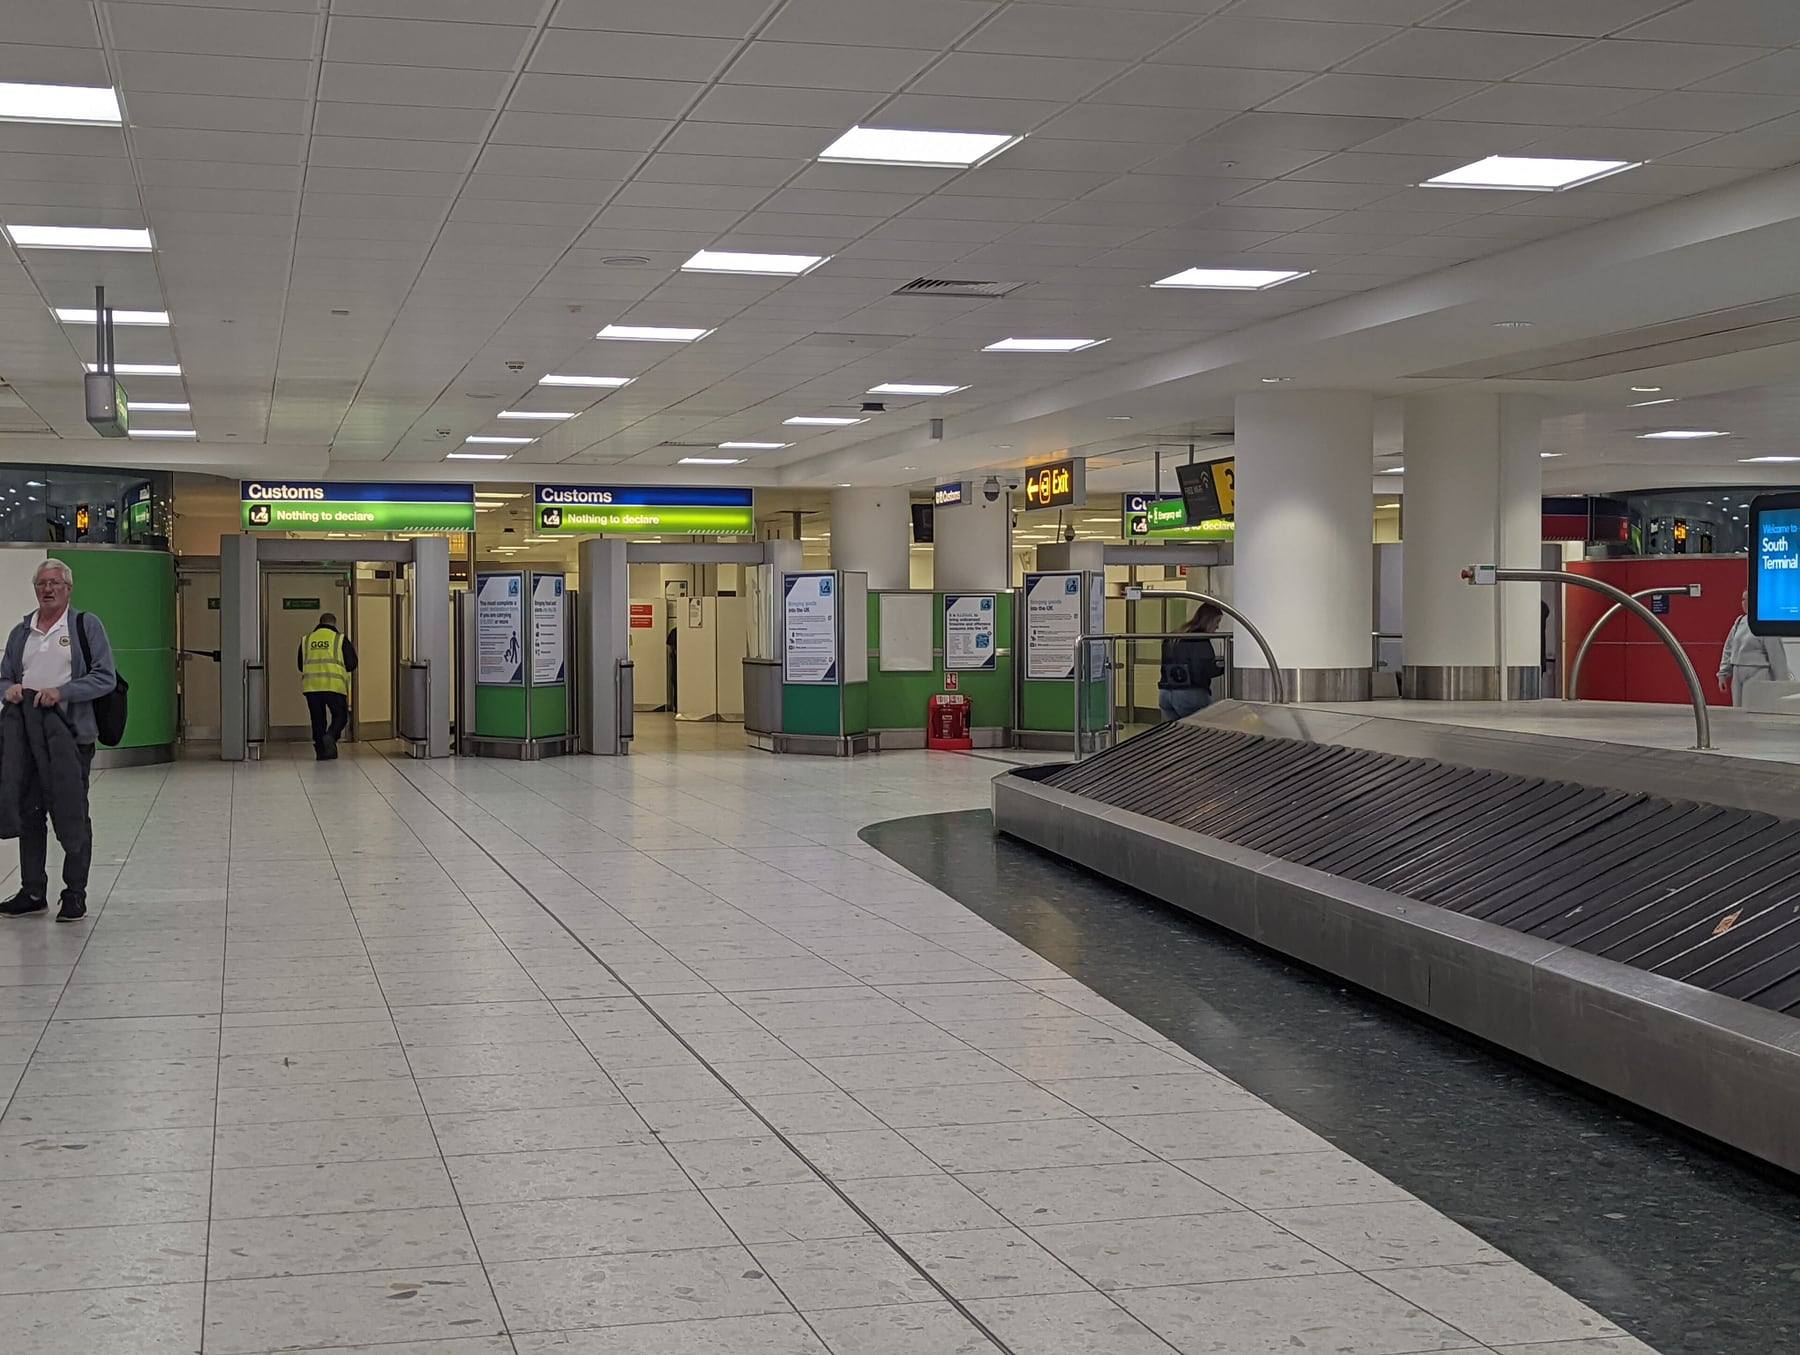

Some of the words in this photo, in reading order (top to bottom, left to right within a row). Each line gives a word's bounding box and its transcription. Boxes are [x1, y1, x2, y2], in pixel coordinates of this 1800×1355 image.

[1052, 468, 1069, 494] Exit
[248, 484, 324, 500] Customs
[541, 487, 612, 503] Customs
[943, 490, 961, 502] Customs
[277, 510, 319, 523] Nothing
[321, 511, 333, 521] to
[335, 511, 374, 522] declare
[567, 513, 608, 526] Nothing
[610, 514, 620, 525] to
[622, 514, 660, 525] declare
[1202, 517, 1235, 531] declare
[1763, 524, 1789, 534] Welcome
[1791, 524, 1797, 533] to
[1762, 536, 1788, 552] South
[1762, 553, 1799, 570] Terminal
